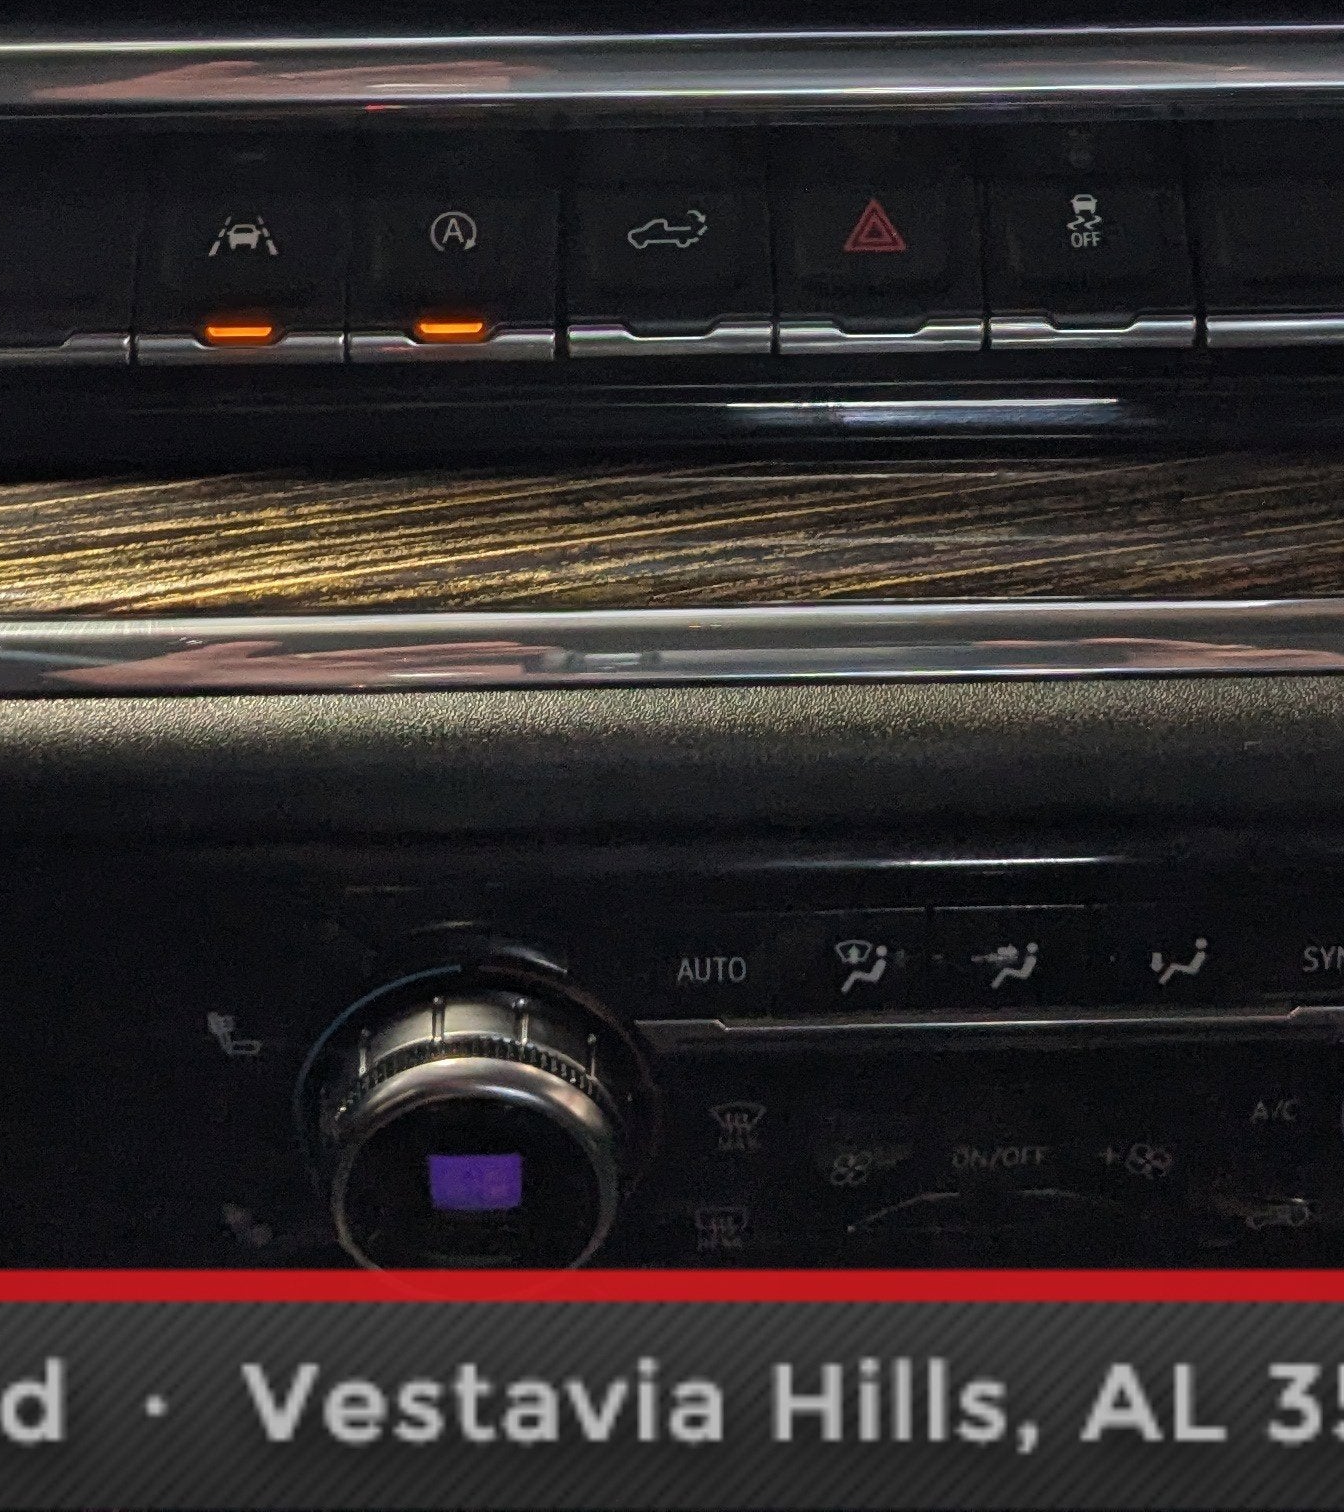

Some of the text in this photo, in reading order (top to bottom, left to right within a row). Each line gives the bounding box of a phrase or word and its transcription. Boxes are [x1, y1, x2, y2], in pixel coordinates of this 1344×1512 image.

[441, 217, 465, 244] A
[1070, 231, 1102, 248] OFF
[676, 955, 748, 983] AUTO
[1249, 1098, 1299, 1124] A/C
